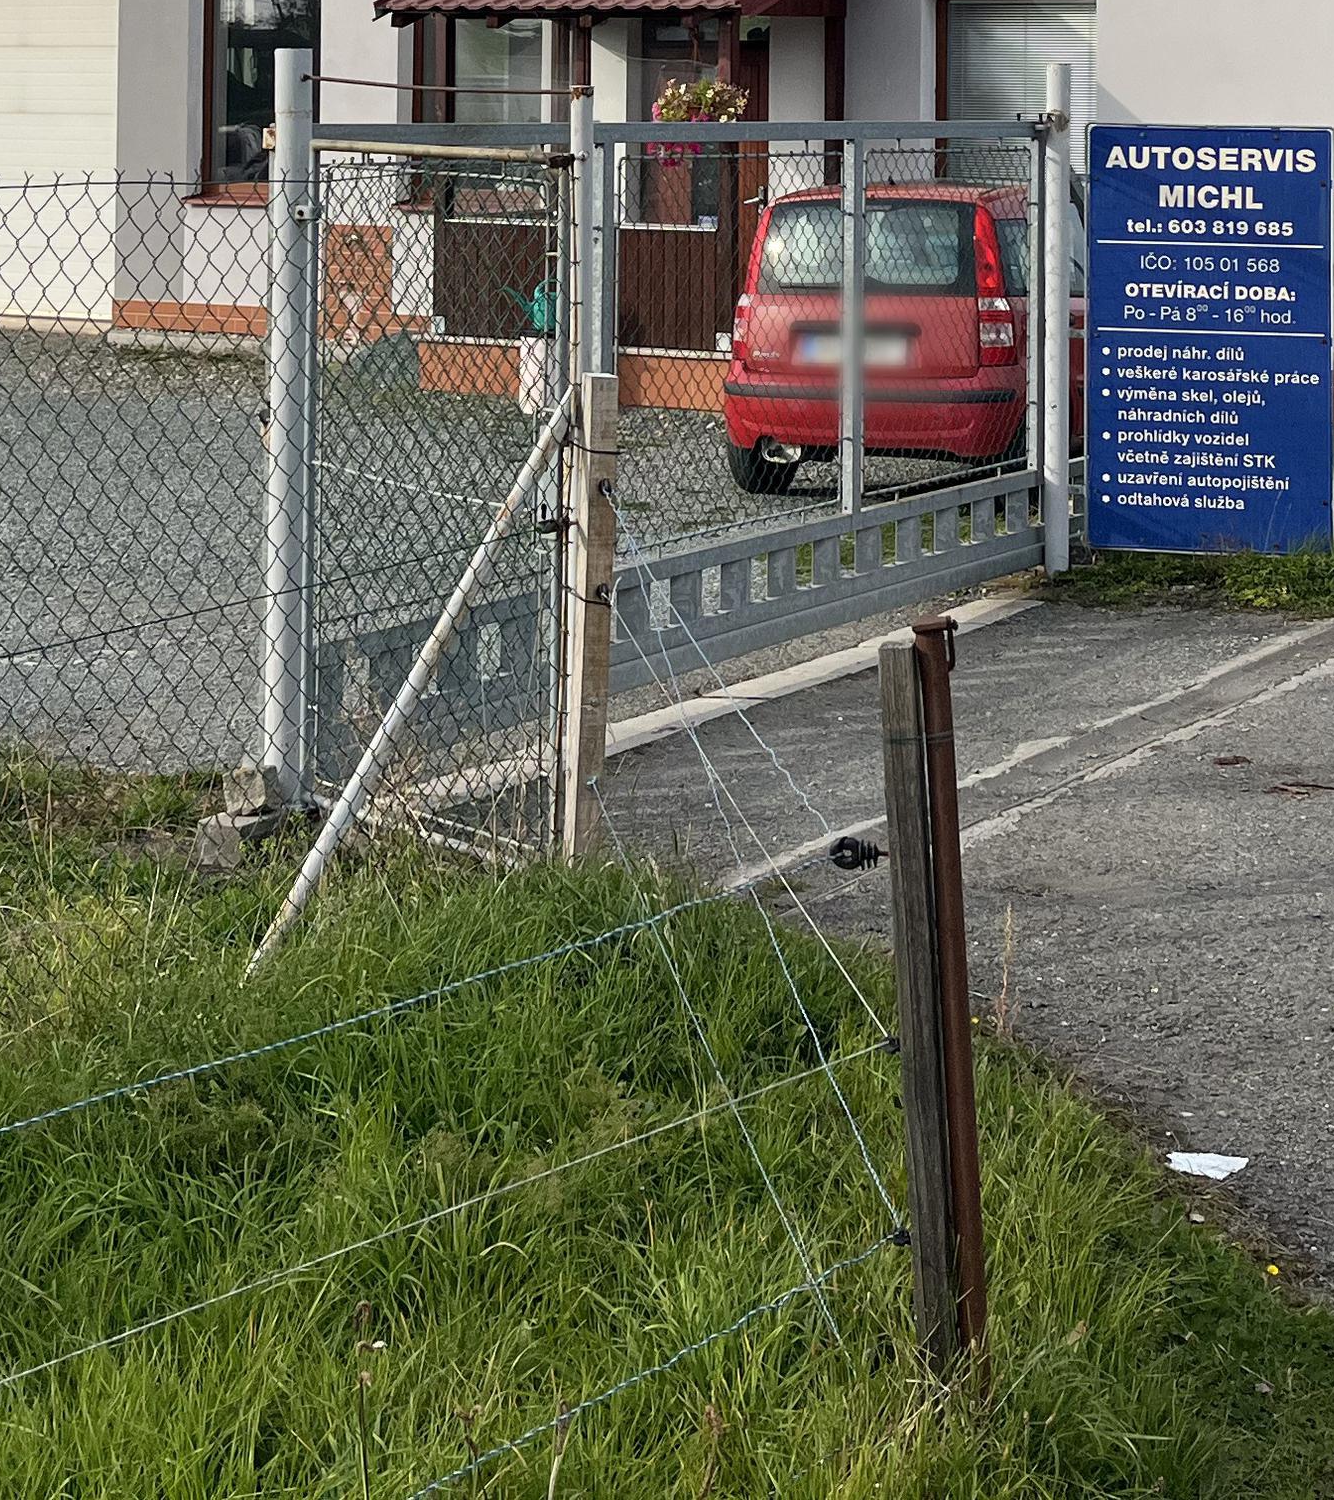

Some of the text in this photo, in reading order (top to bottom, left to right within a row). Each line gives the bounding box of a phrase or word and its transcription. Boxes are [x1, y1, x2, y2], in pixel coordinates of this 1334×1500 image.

[1105, 145, 1316, 173] AUTOSERVIS
[1158, 184, 1263, 210] MICHL
[1127, 219, 1294, 236] tel.: 603 819 685
[1140, 251, 1280, 273] IČO: 105 01 568
[1125, 280, 1296, 301] OTEVÍRACÍ DOBA:
[1123, 305, 1145, 320] Po
[1160, 306, 1181, 321] Pá
[1261, 309, 1296, 324] hod.
[1117, 345, 1244, 361] prodej náhr. dílů
[1117, 366, 1320, 386] veškeré karosářské práce
[1117, 387, 1266, 406] výměna skel, olejů,
[1117, 408, 1239, 424] náhradních dílů
[1117, 429, 1249, 446] prohlídky vozidel
[1117, 450, 1276, 468] včetně zajištění STK
[1117, 471, 1289, 491] uzavření autopojištění
[1117, 492, 1245, 510] odtahová služba
